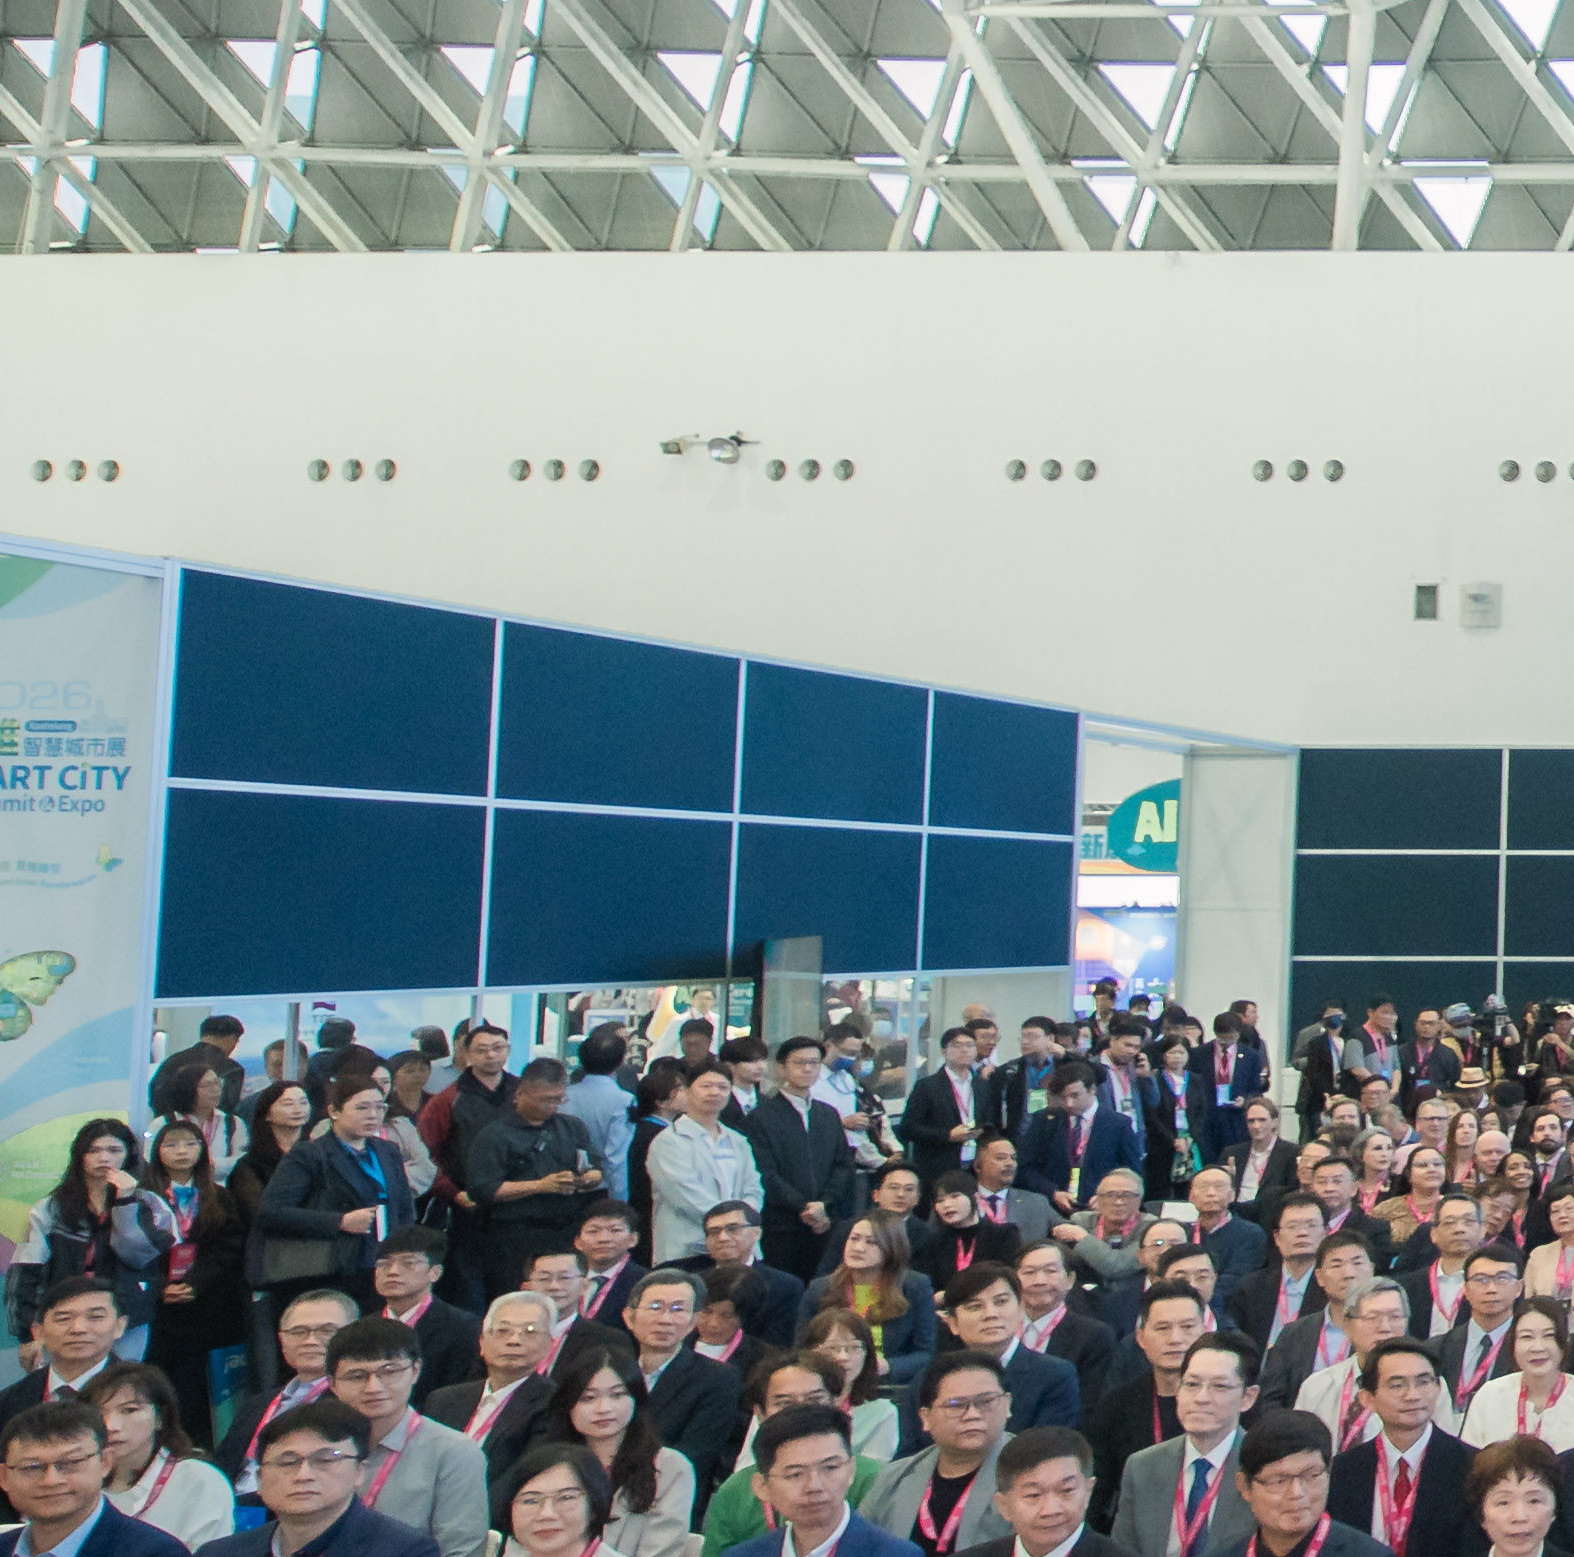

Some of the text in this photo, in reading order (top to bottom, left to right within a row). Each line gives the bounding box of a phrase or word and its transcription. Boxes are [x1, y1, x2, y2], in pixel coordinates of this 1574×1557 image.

[23, 737, 128, 758] 智慧城市展
[58, 796, 106, 816] Expo
[1133, 799, 1178, 843] AI
